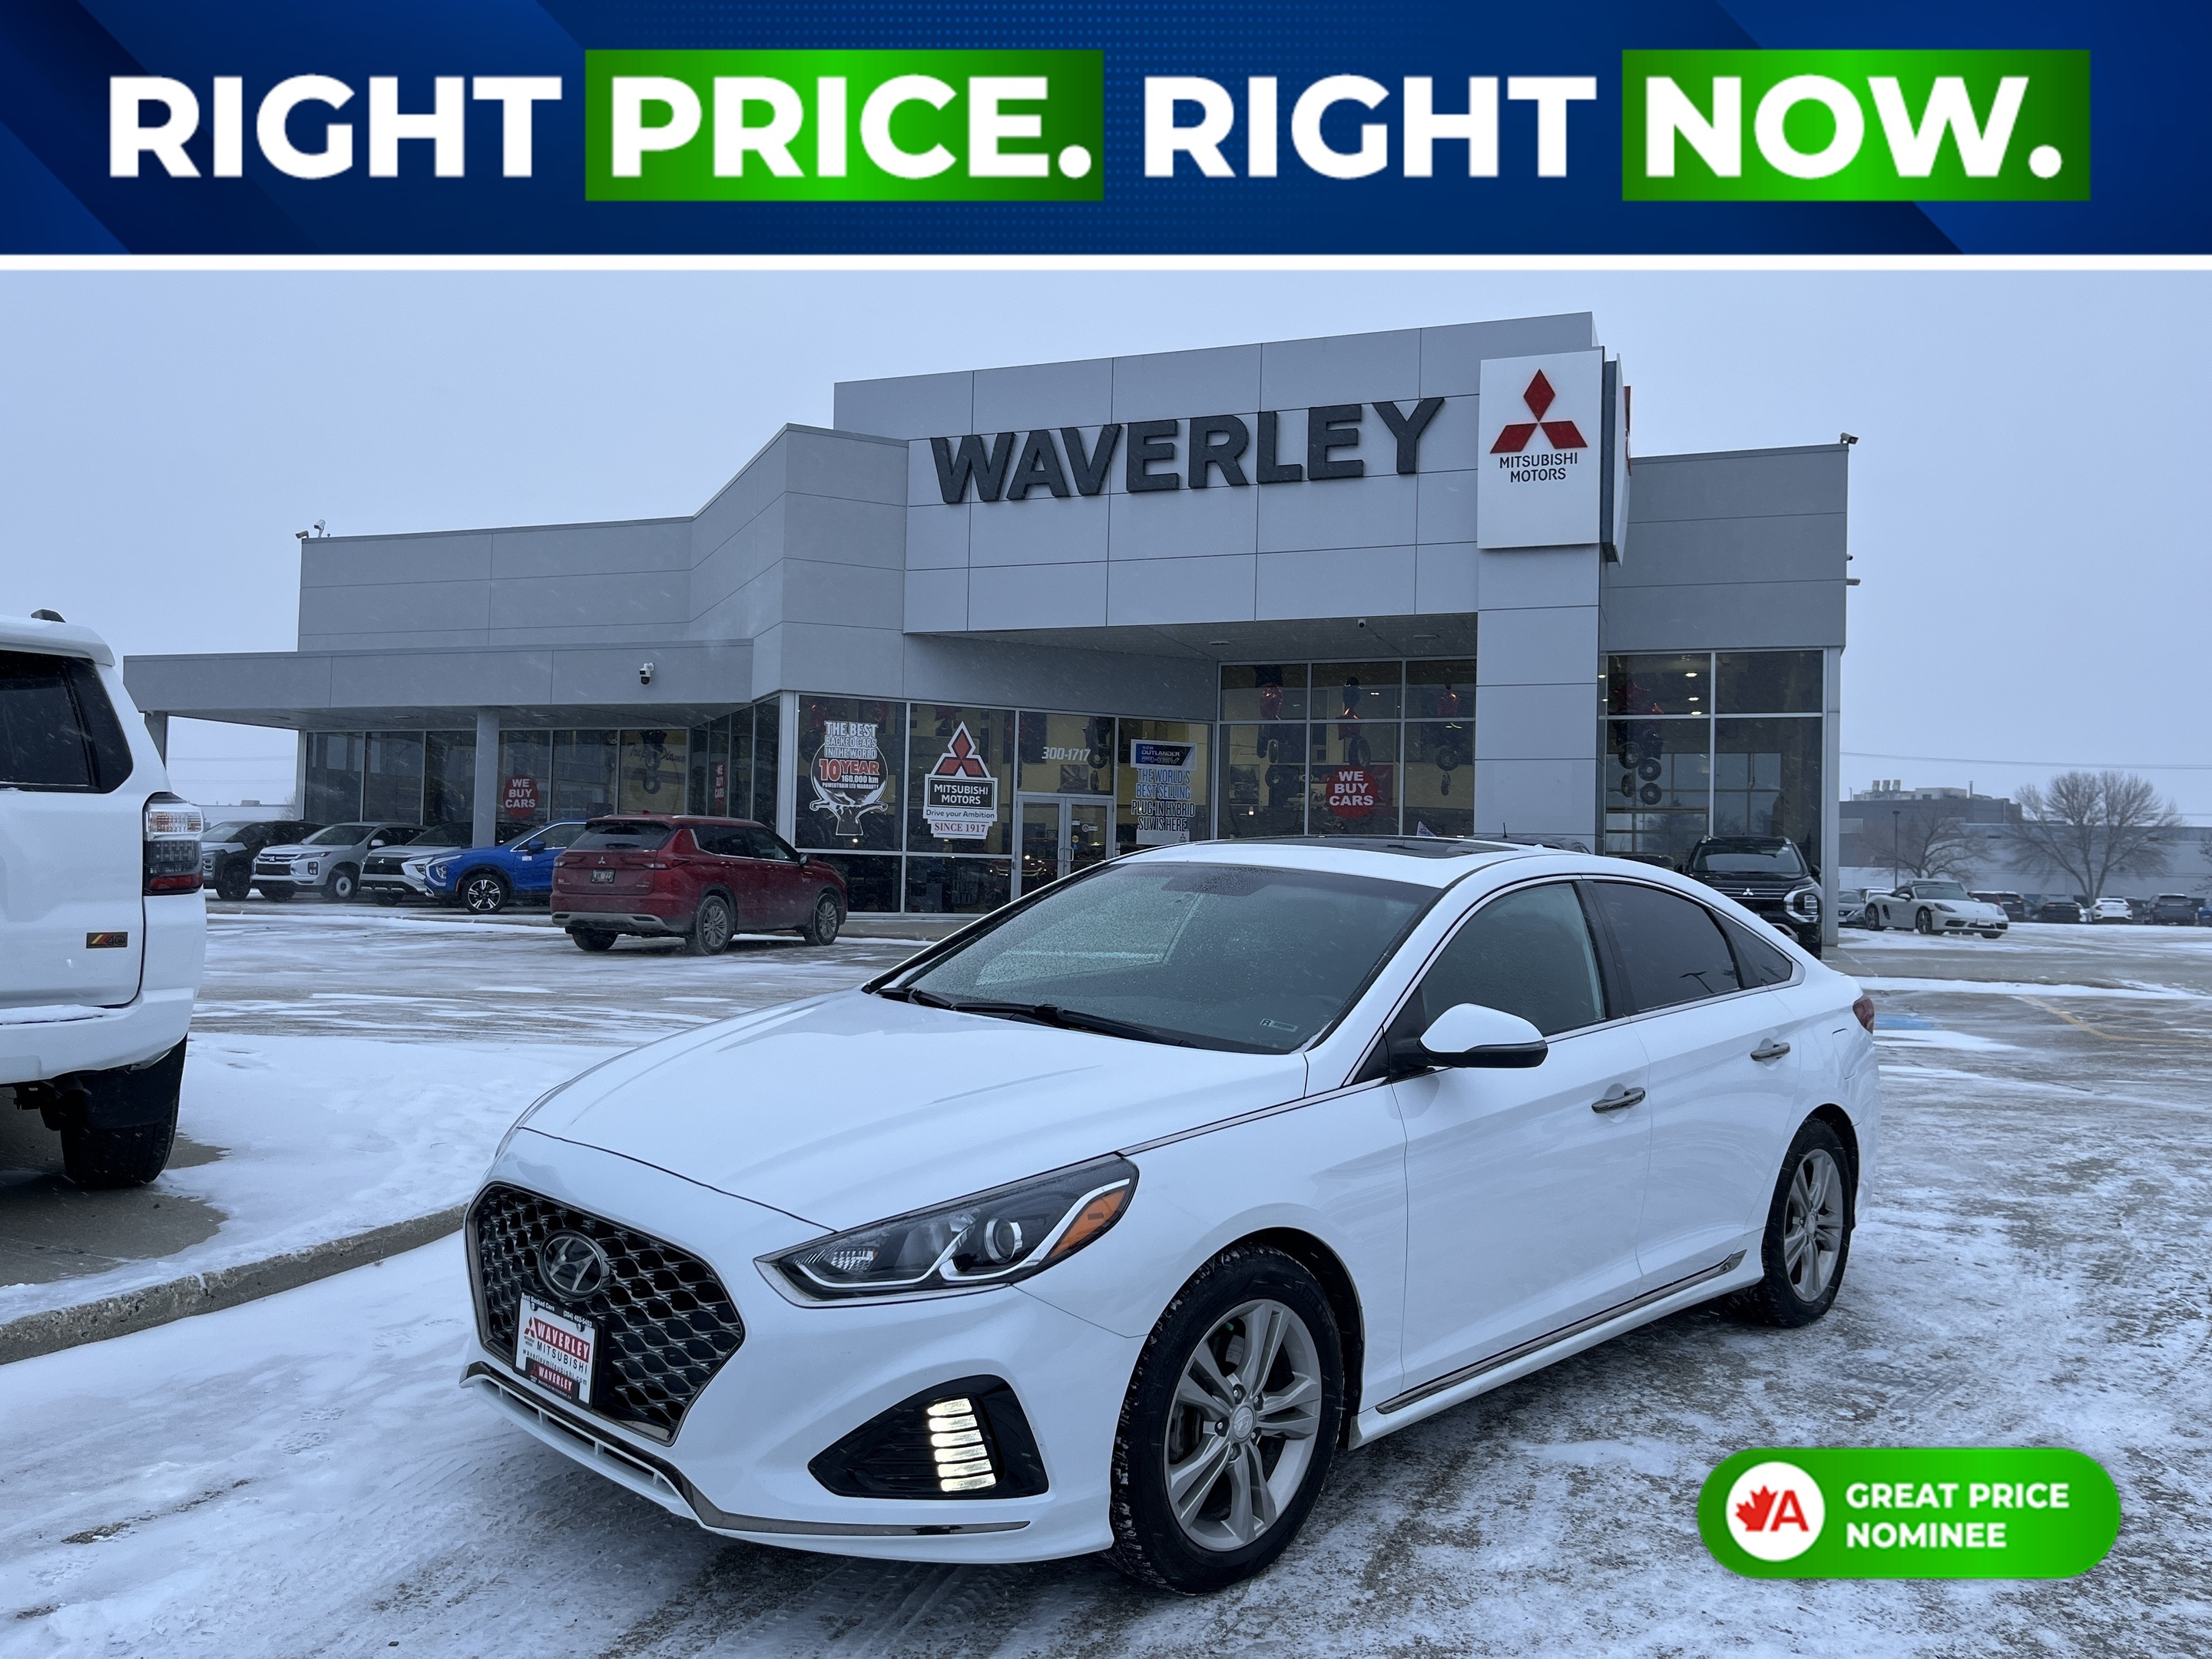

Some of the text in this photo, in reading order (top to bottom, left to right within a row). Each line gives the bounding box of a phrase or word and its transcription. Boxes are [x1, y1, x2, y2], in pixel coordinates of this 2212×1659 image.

[930, 397, 1445, 504] WAVERLEY
[1499, 452, 1578, 469] MITSUBISHI
[1510, 468, 1566, 483] MOTORS
[825, 721, 878, 737] THE BEST
[826, 737, 877, 748] BACKED CARS
[826, 747, 877, 759] IN THE WORLD
[1041, 746, 1091, 761] 300-1717
[1141, 756, 1181, 764] PHEV
[820, 759, 880, 782] 10 YEAR
[1137, 769, 1190, 784] THE WORLD'S
[1339, 770, 1364, 781] WE
[512, 778, 530, 788] WE
[842, 775, 867, 783] 160,000
[508, 789, 533, 798] BUY
[934, 784, 988, 795] MITSUBISHI
[1137, 783, 1190, 800] BEST SELLING
[1334, 783, 1369, 794] BUY
[505, 799, 536, 808] CARS
[941, 794, 982, 805] MOTORS
[1329, 795, 1374, 806] CARS
[1132, 800, 1195, 816] PLUG-IN HYBRID
[934, 822, 986, 833] SINCE 1917
[1138, 816, 1155, 831] SUV
[1156, 817, 1164, 831] IS
[538, 1322, 590, 1359] WAVERLEY
[537, 1341, 588, 1375] MITSUBISHI
[538, 1366, 573, 1392] WAVERLEY
